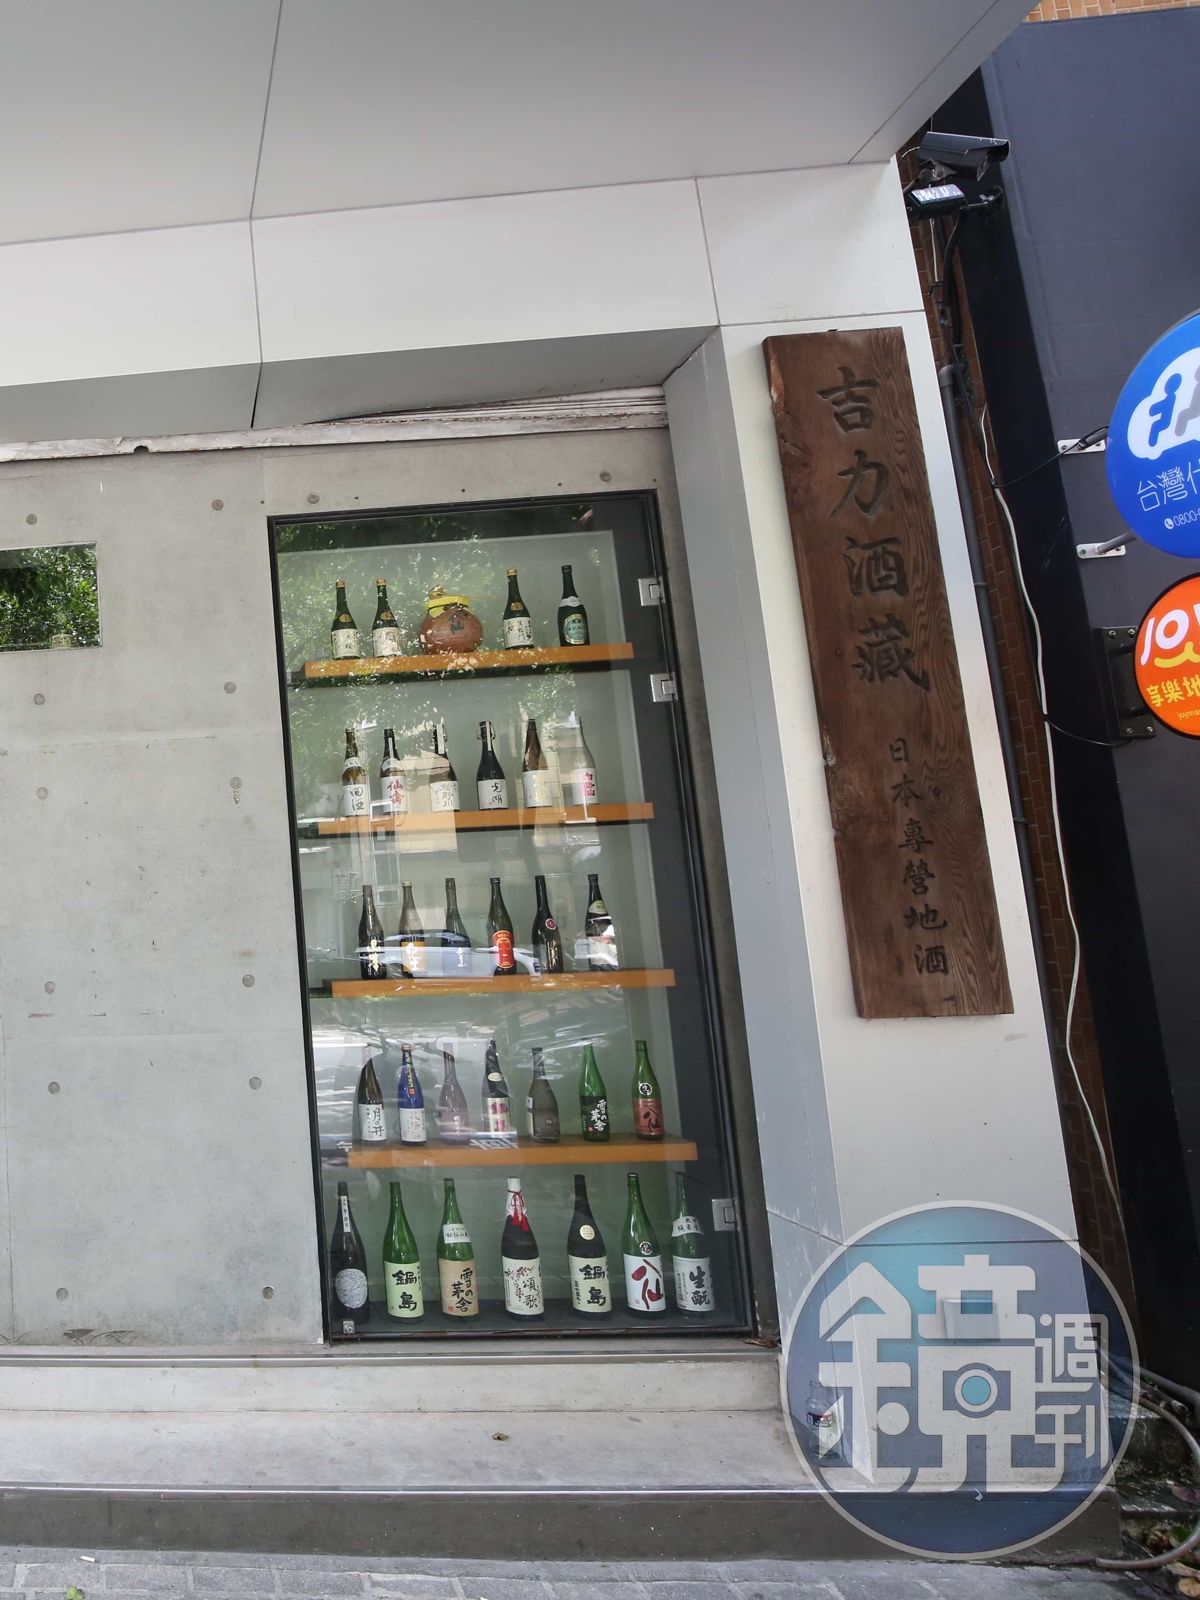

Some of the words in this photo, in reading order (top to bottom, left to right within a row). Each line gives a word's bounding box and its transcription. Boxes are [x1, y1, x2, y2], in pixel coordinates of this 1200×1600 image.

[816, 366, 930, 691] 吉力酒藏
[1140, 603, 1200, 666] JO
[887, 738, 949, 976] 日本專營地酒
[392, 1270, 417, 1311] 鍋島
[579, 1264, 606, 1306] 鍋島
